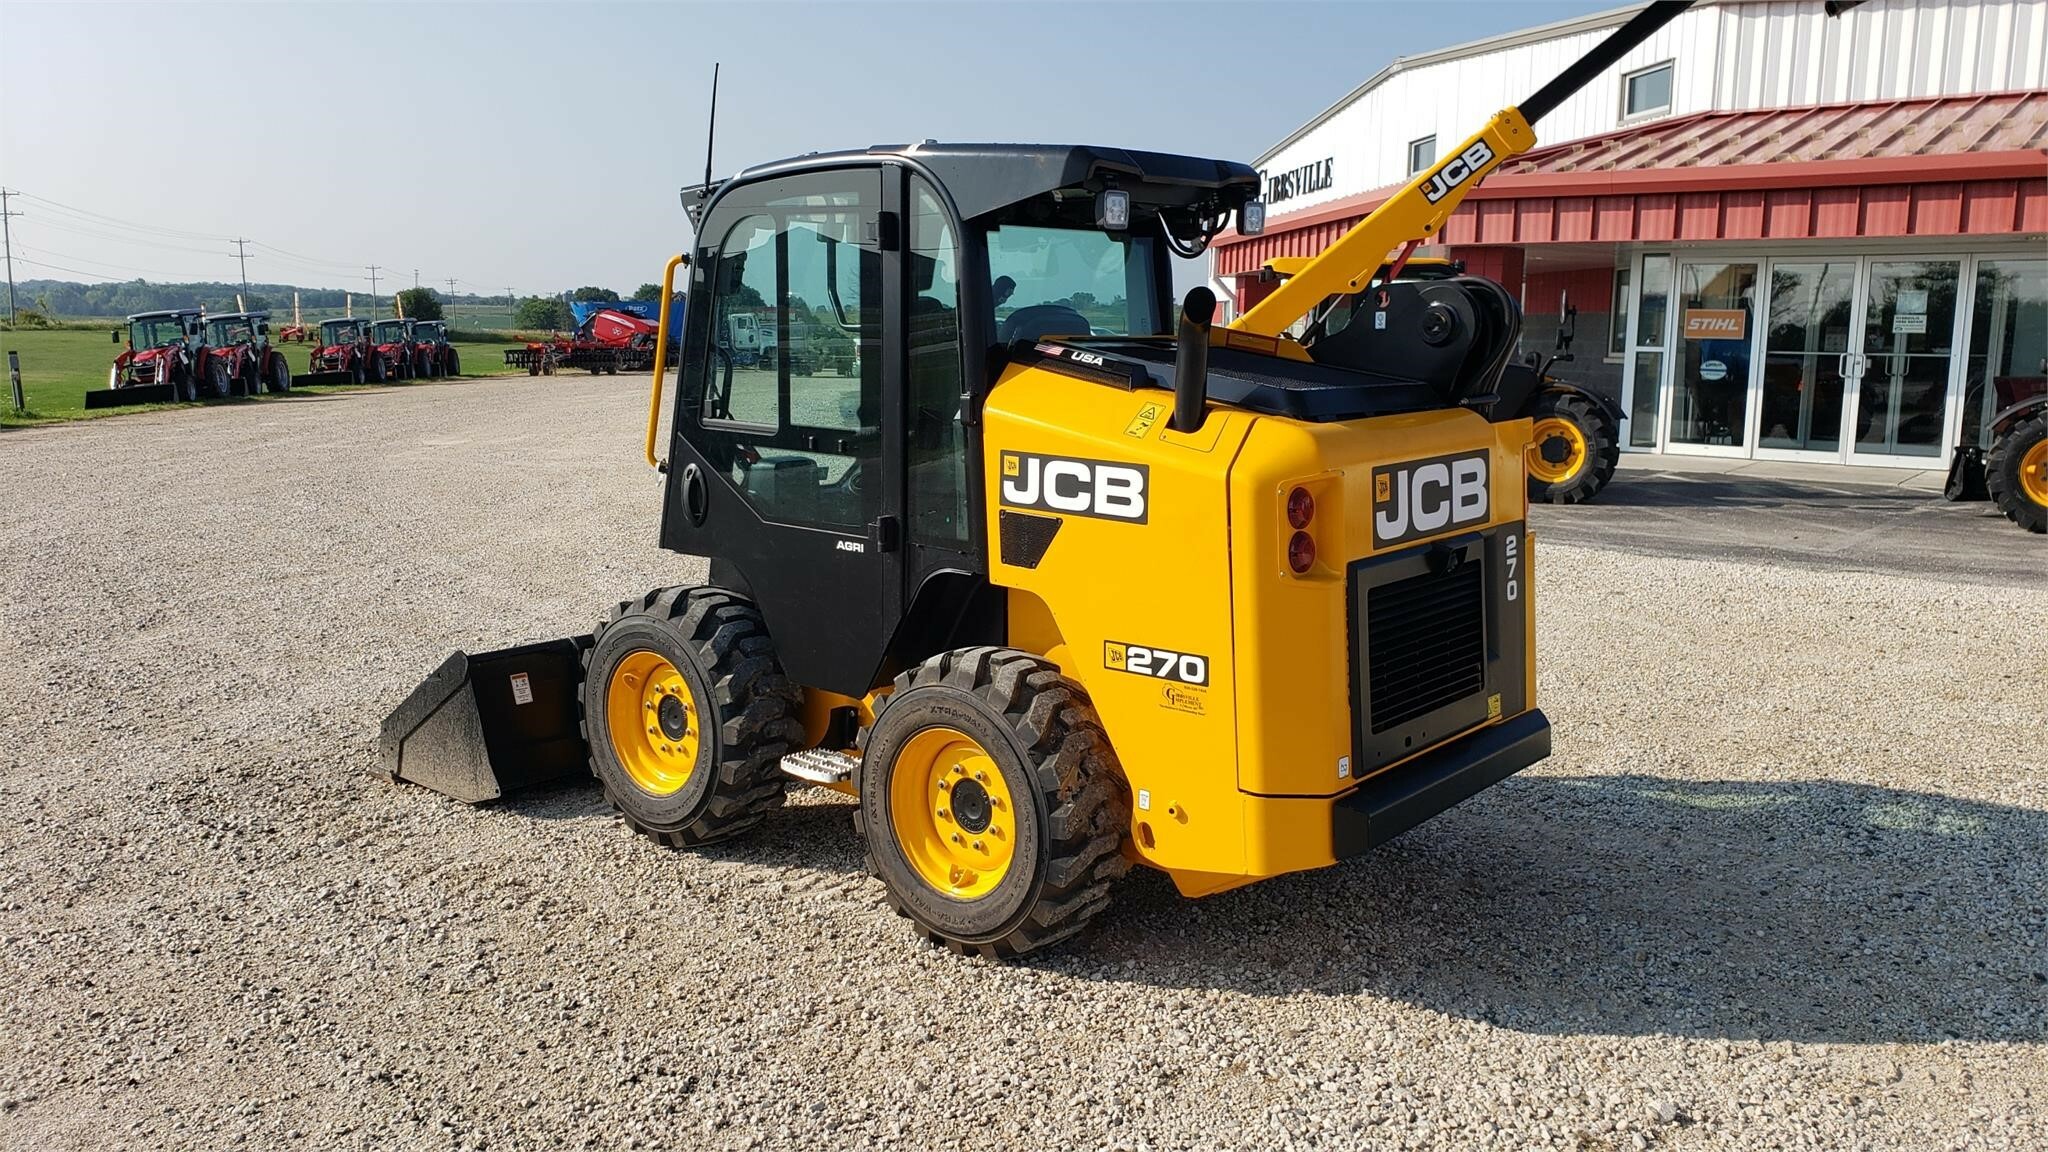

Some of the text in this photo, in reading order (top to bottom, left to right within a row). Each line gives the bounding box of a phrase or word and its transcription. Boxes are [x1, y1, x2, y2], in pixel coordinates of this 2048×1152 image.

[1426, 141, 1494, 203] JCB
[1687, 317, 1739, 331] STIHL
[1070, 351, 1104, 366] USA
[1003, 458, 1145, 519] JCB
[1376, 457, 1488, 541] JCB
[836, 540, 864, 553] AGRI
[1505, 535, 1518, 601] 270
[1127, 646, 1206, 684] 270
